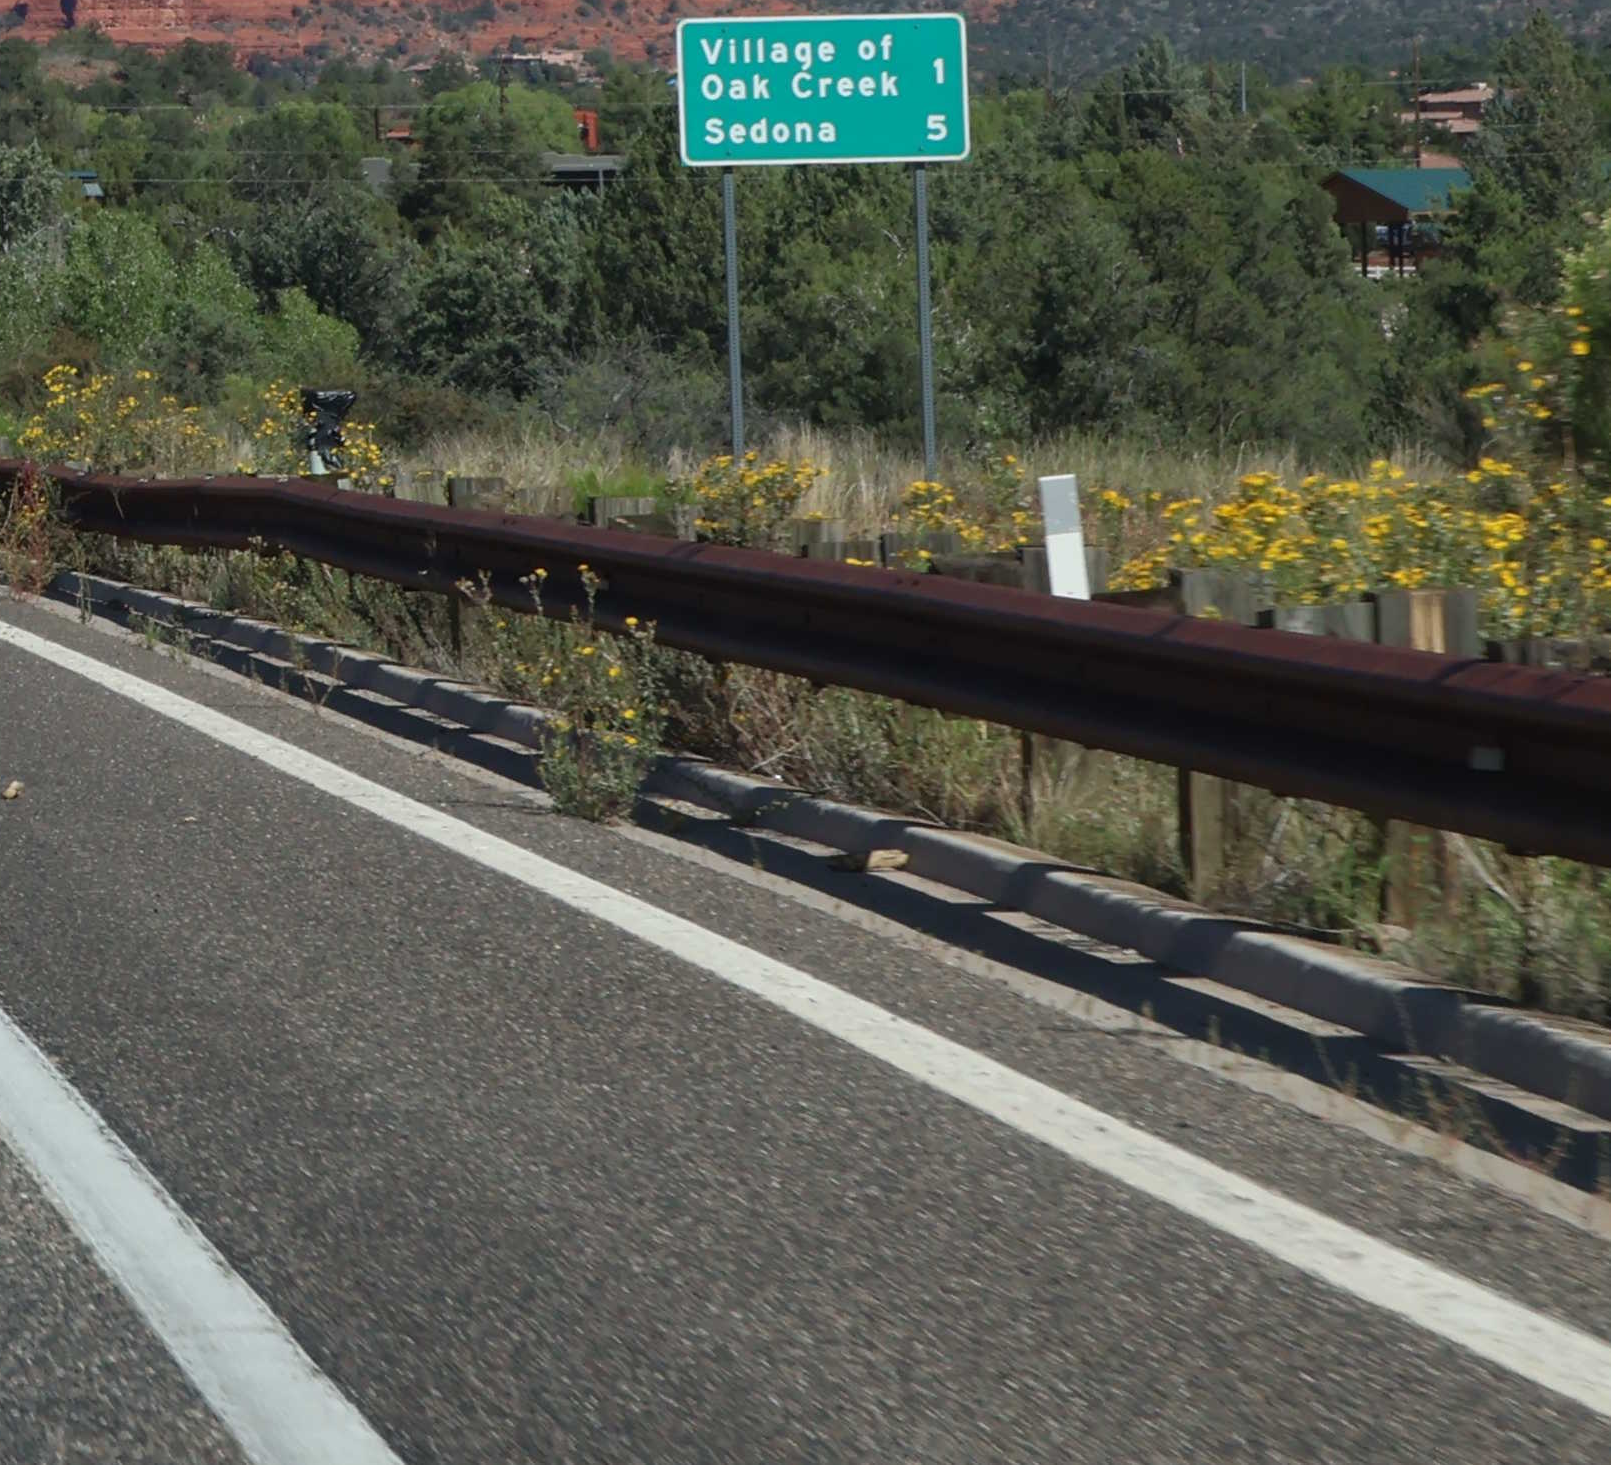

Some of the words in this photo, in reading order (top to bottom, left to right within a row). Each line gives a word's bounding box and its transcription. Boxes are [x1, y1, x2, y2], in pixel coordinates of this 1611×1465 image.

[701, 38, 835, 71] Village
[858, 34, 892, 61] of
[701, 74, 770, 100] Oak
[791, 71, 898, 99] Creek
[932, 58, 946, 84] 1
[704, 118, 836, 145] Sedona
[927, 114, 948, 141] 5
